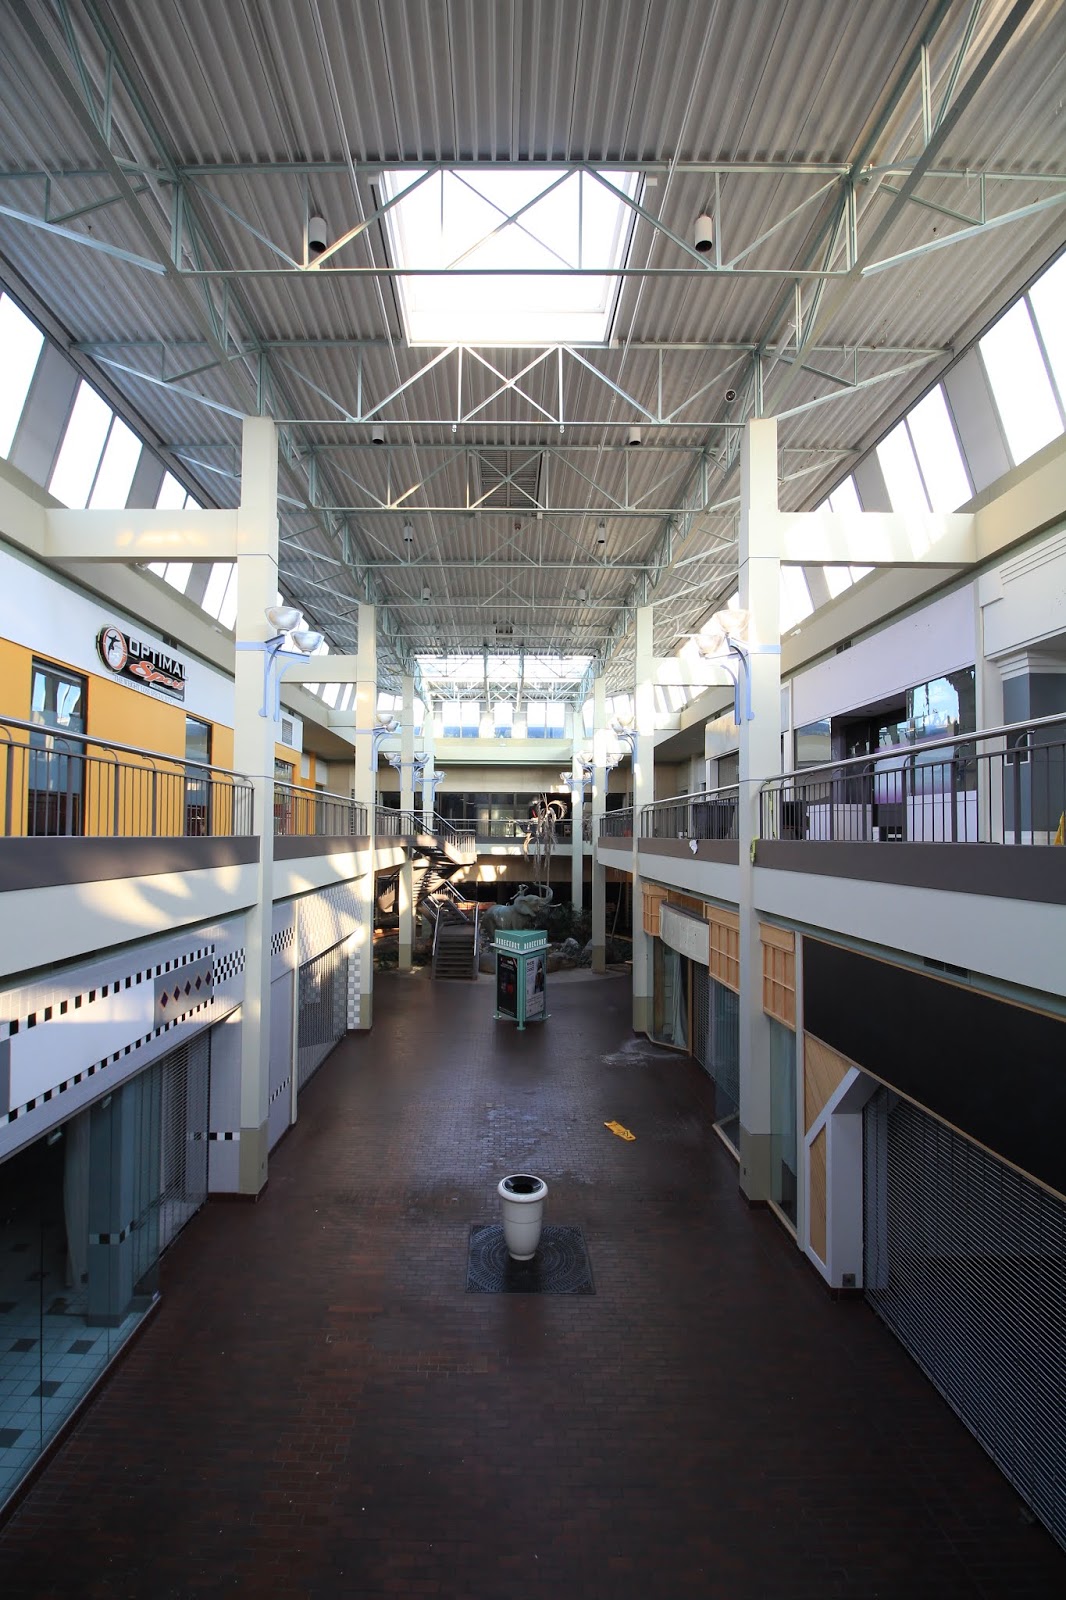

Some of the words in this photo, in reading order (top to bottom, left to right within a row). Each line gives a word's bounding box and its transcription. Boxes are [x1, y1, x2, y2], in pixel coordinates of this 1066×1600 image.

[129, 637, 188, 681] OPTIMAL
[496, 937, 520, 950] DIRECTORY
[523, 937, 547, 950] DIRECTORY
